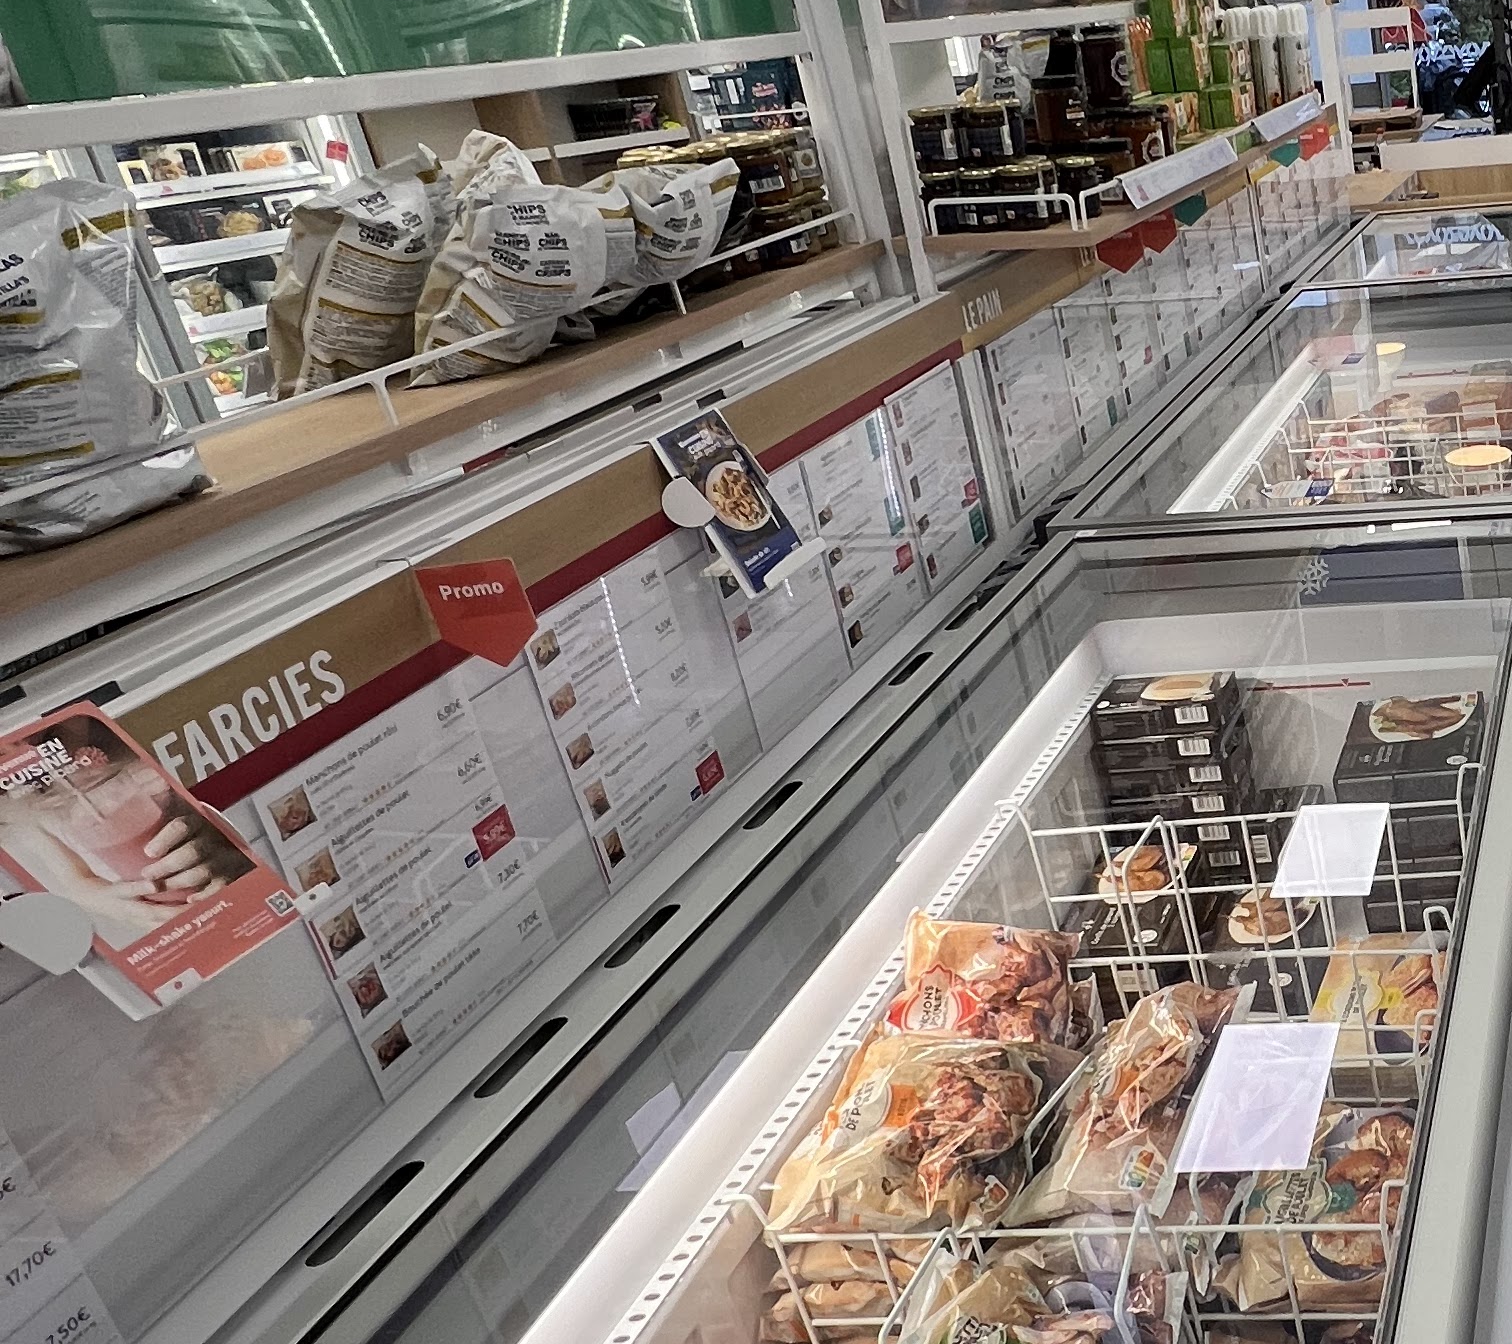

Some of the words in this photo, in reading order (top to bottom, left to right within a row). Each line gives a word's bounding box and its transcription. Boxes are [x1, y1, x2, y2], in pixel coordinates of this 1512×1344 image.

[438, 582, 504, 601] Promo
[152, 649, 348, 789] FARCIES
[36, 737, 65, 757] EN
[0, 750, 73, 792] CUISINE
[5, 1240, 57, 1288] 17,70€
